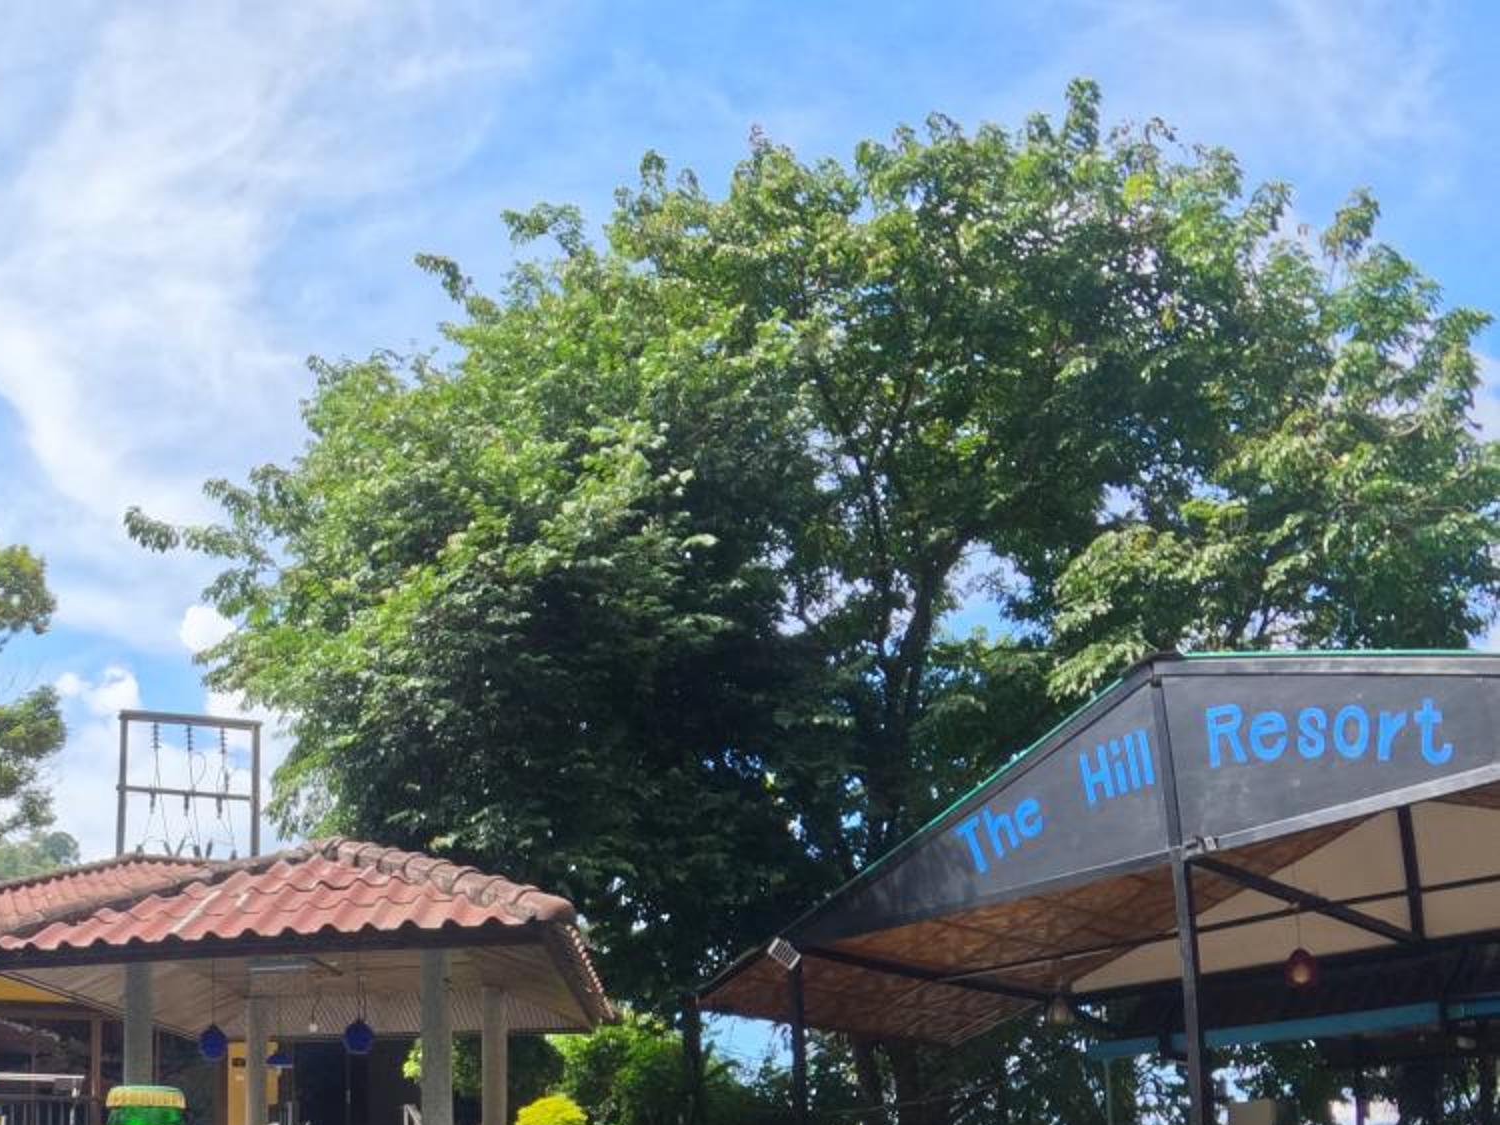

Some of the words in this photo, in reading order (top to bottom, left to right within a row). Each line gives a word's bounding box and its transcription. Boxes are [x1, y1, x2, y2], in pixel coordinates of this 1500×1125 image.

[955, 796, 1044, 874] The
[1079, 727, 1156, 806] Hill
[1205, 697, 1455, 769] Resort
